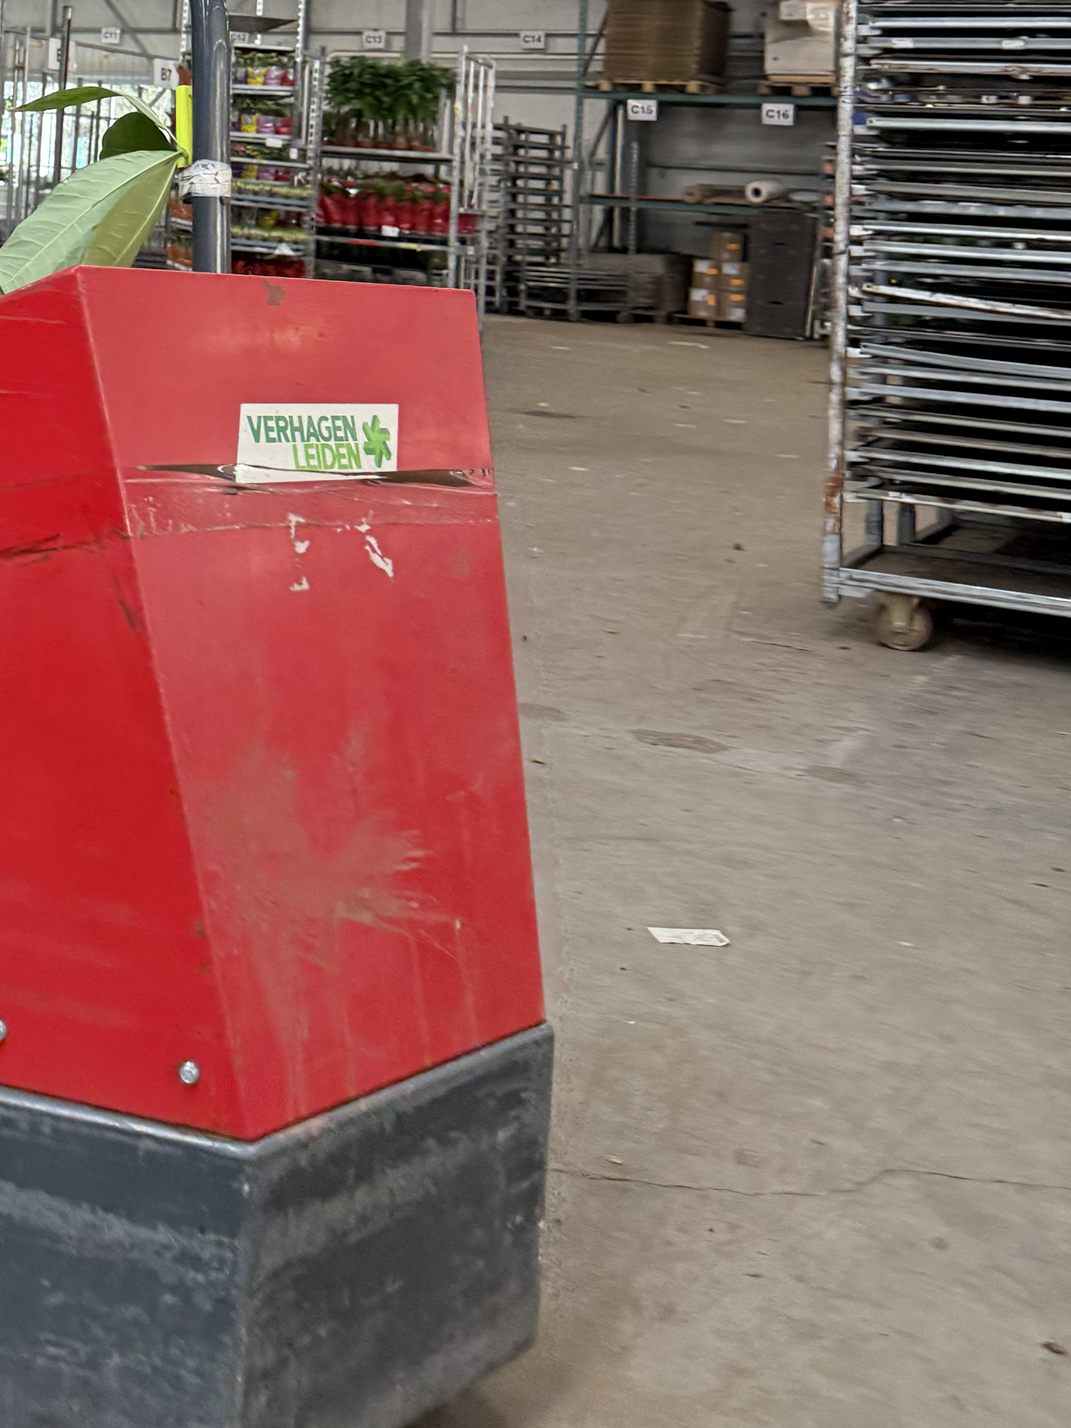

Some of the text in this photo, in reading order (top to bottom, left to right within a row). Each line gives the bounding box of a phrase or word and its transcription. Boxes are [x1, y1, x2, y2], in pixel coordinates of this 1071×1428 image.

[631, 105, 654, 115] C15
[765, 109, 790, 120] C16
[246, 415, 358, 444] VERHAGEN
[292, 442, 362, 470] LEIDEN
